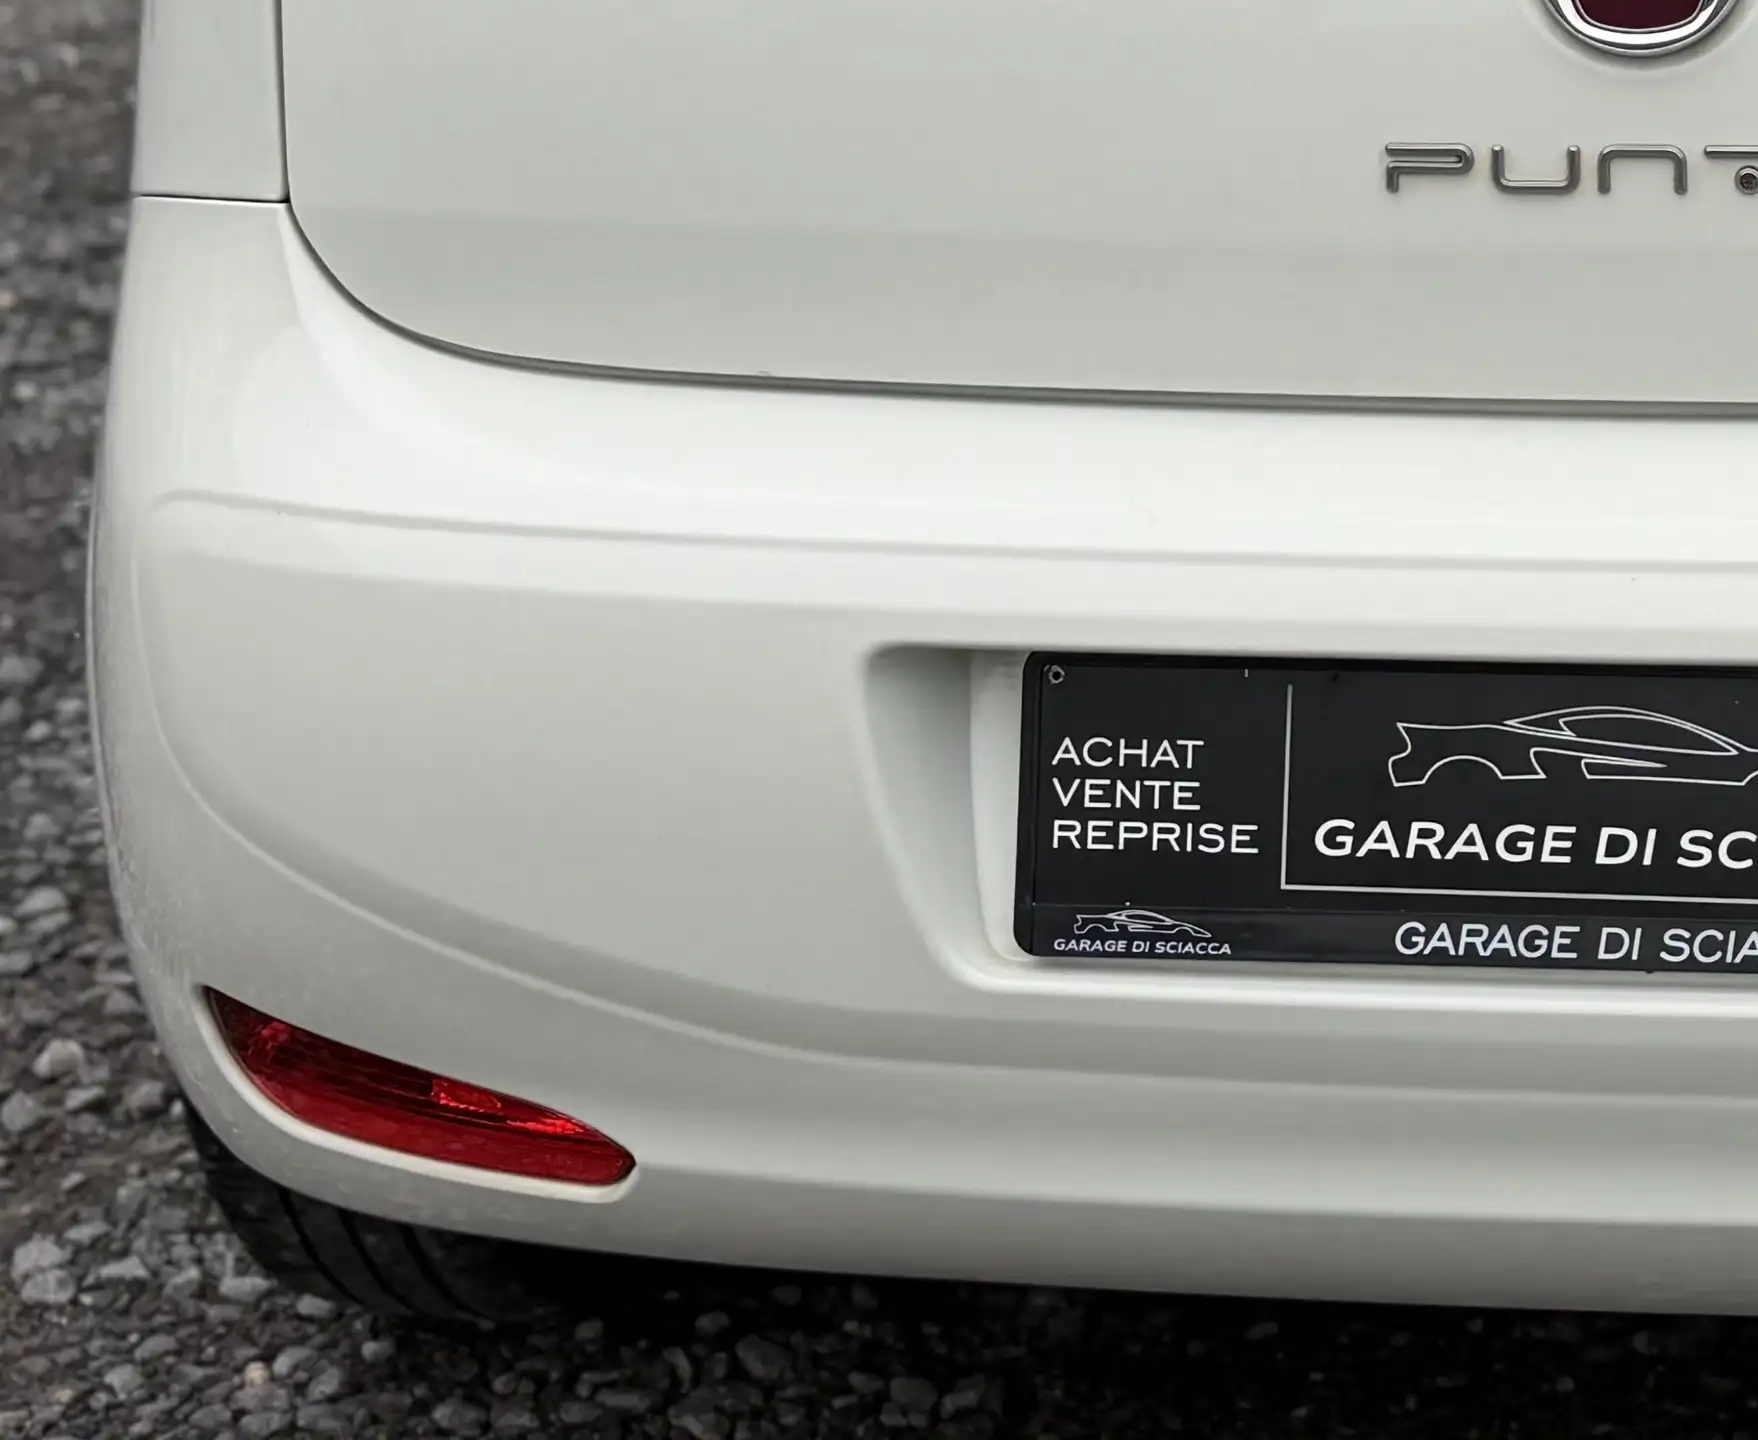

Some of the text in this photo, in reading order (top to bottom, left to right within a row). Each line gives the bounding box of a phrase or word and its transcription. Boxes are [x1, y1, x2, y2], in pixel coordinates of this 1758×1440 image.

[1051, 736, 1205, 769] ACHAT
[1052, 777, 1202, 811] VENTE
[1052, 819, 1260, 854] REPRISE
[1314, 818, 1578, 864] GARAGE
[1594, 826, 1657, 866] DI
[1053, 938, 1232, 955] GARAGE DI SCIACCA
[1394, 921, 1581, 959] GARAGE
[1597, 926, 1643, 961] DI
